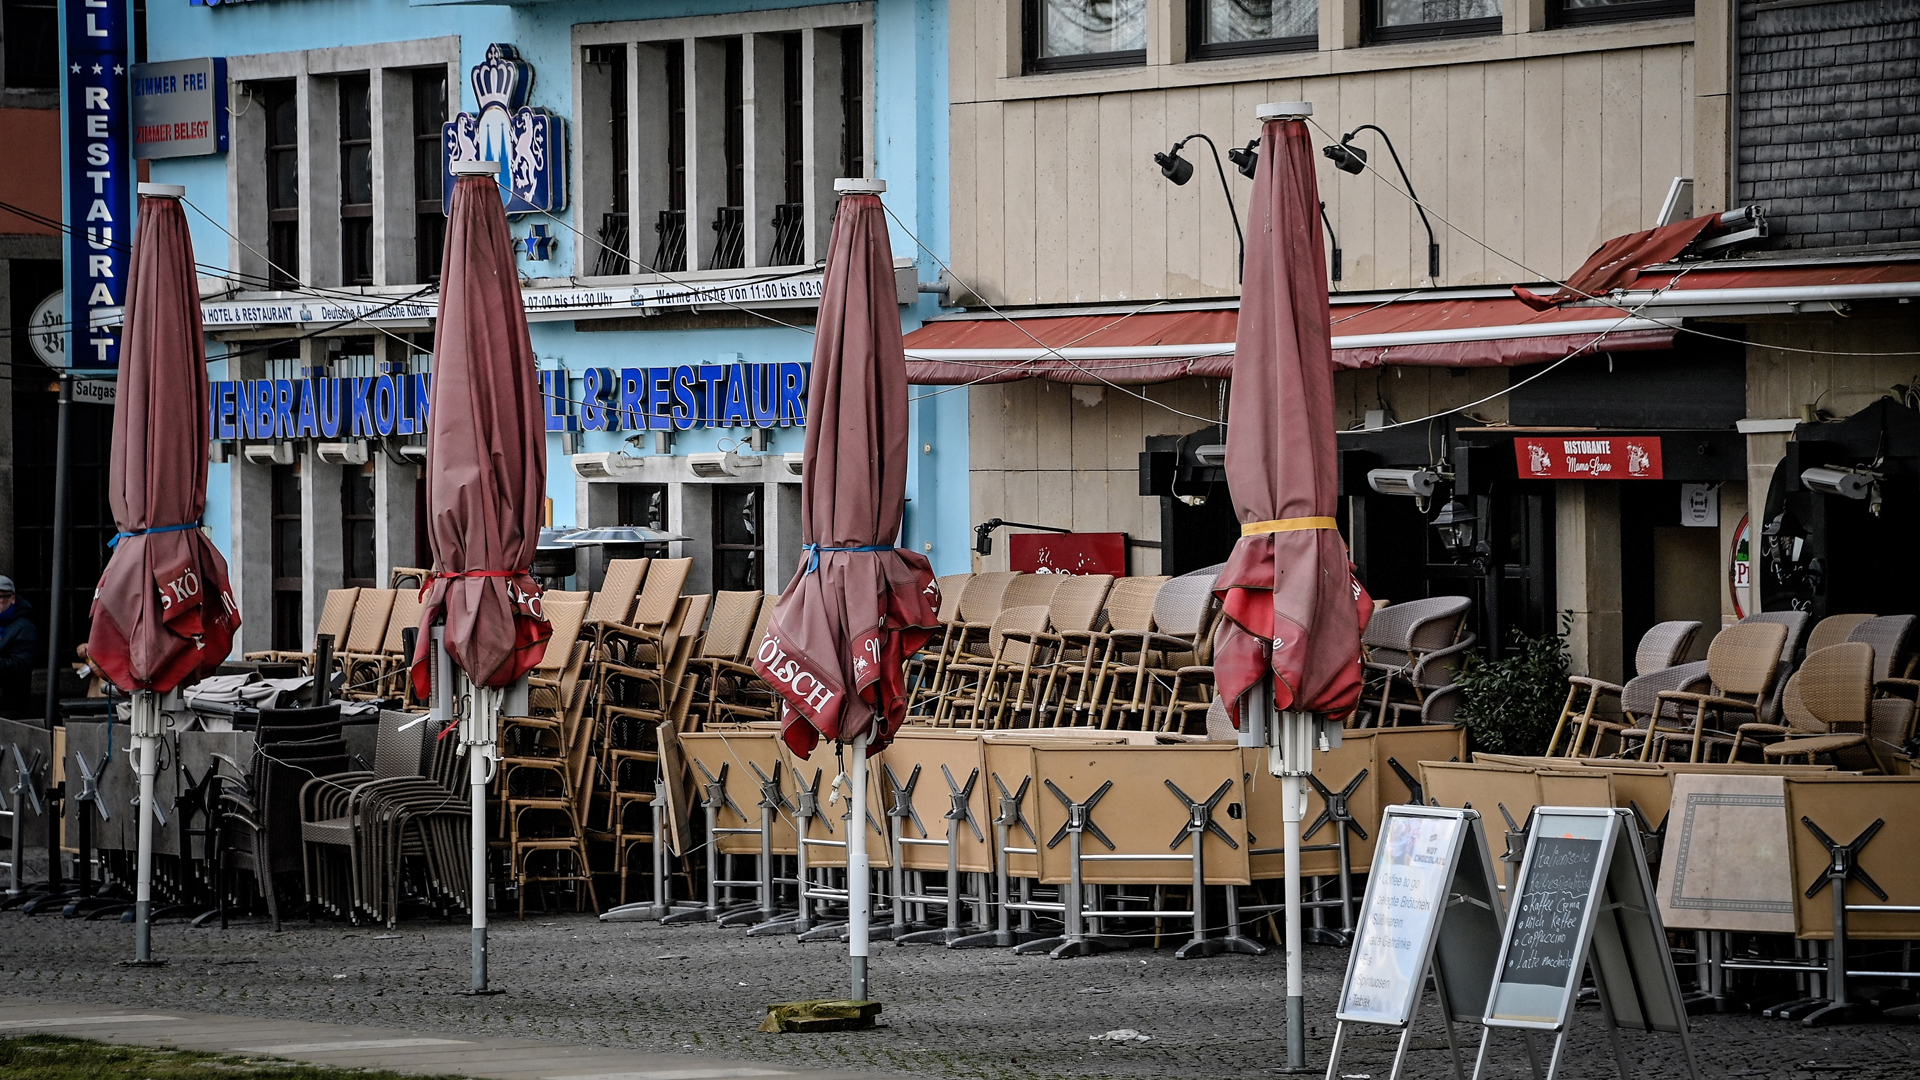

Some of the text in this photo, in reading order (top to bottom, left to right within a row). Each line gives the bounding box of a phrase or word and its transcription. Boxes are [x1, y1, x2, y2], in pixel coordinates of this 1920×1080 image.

[136, 72, 207, 97] ZIMMER FREI
[137, 120, 209, 144] ZIMMER BELEGT
[528, 295, 552, 310] 07:00
[554, 294, 568, 309] bis
[571, 293, 594, 308] 11:30
[596, 291, 613, 307] Uhr
[656, 288, 691, 304] Warme
[694, 285, 726, 302] Küche
[728, 287, 748, 300] von
[750, 284, 778, 299] 11:00
[780, 282, 797, 298] bis
[208, 308, 233, 323] HOTEL
[235, 308, 241, 322] &
[242, 306, 292, 321] RESTAURANT
[321, 304, 355, 320] Deutsche
[363, 303, 405, 318] Italienische
[407, 303, 431, 316] Küche
[76, 381, 116, 400] Salzgas
[581, 366, 607, 431] &
[621, 361, 806, 430] RESTAUR
[1563, 440, 1611, 455] RISTORANTE
[1566, 455, 1590, 473] Mama
[1533, 843, 1591, 869] Italienische
[1403, 877, 1410, 888] to
[1410, 879, 1420, 891] go
[1529, 893, 1554, 915] Kaffee
[1524, 910, 1577, 929] Milch Kaffee
[1520, 927, 1566, 949] Cappuccino
[1516, 949, 1540, 970] Latte
[1353, 993, 1371, 1008] Tabak
